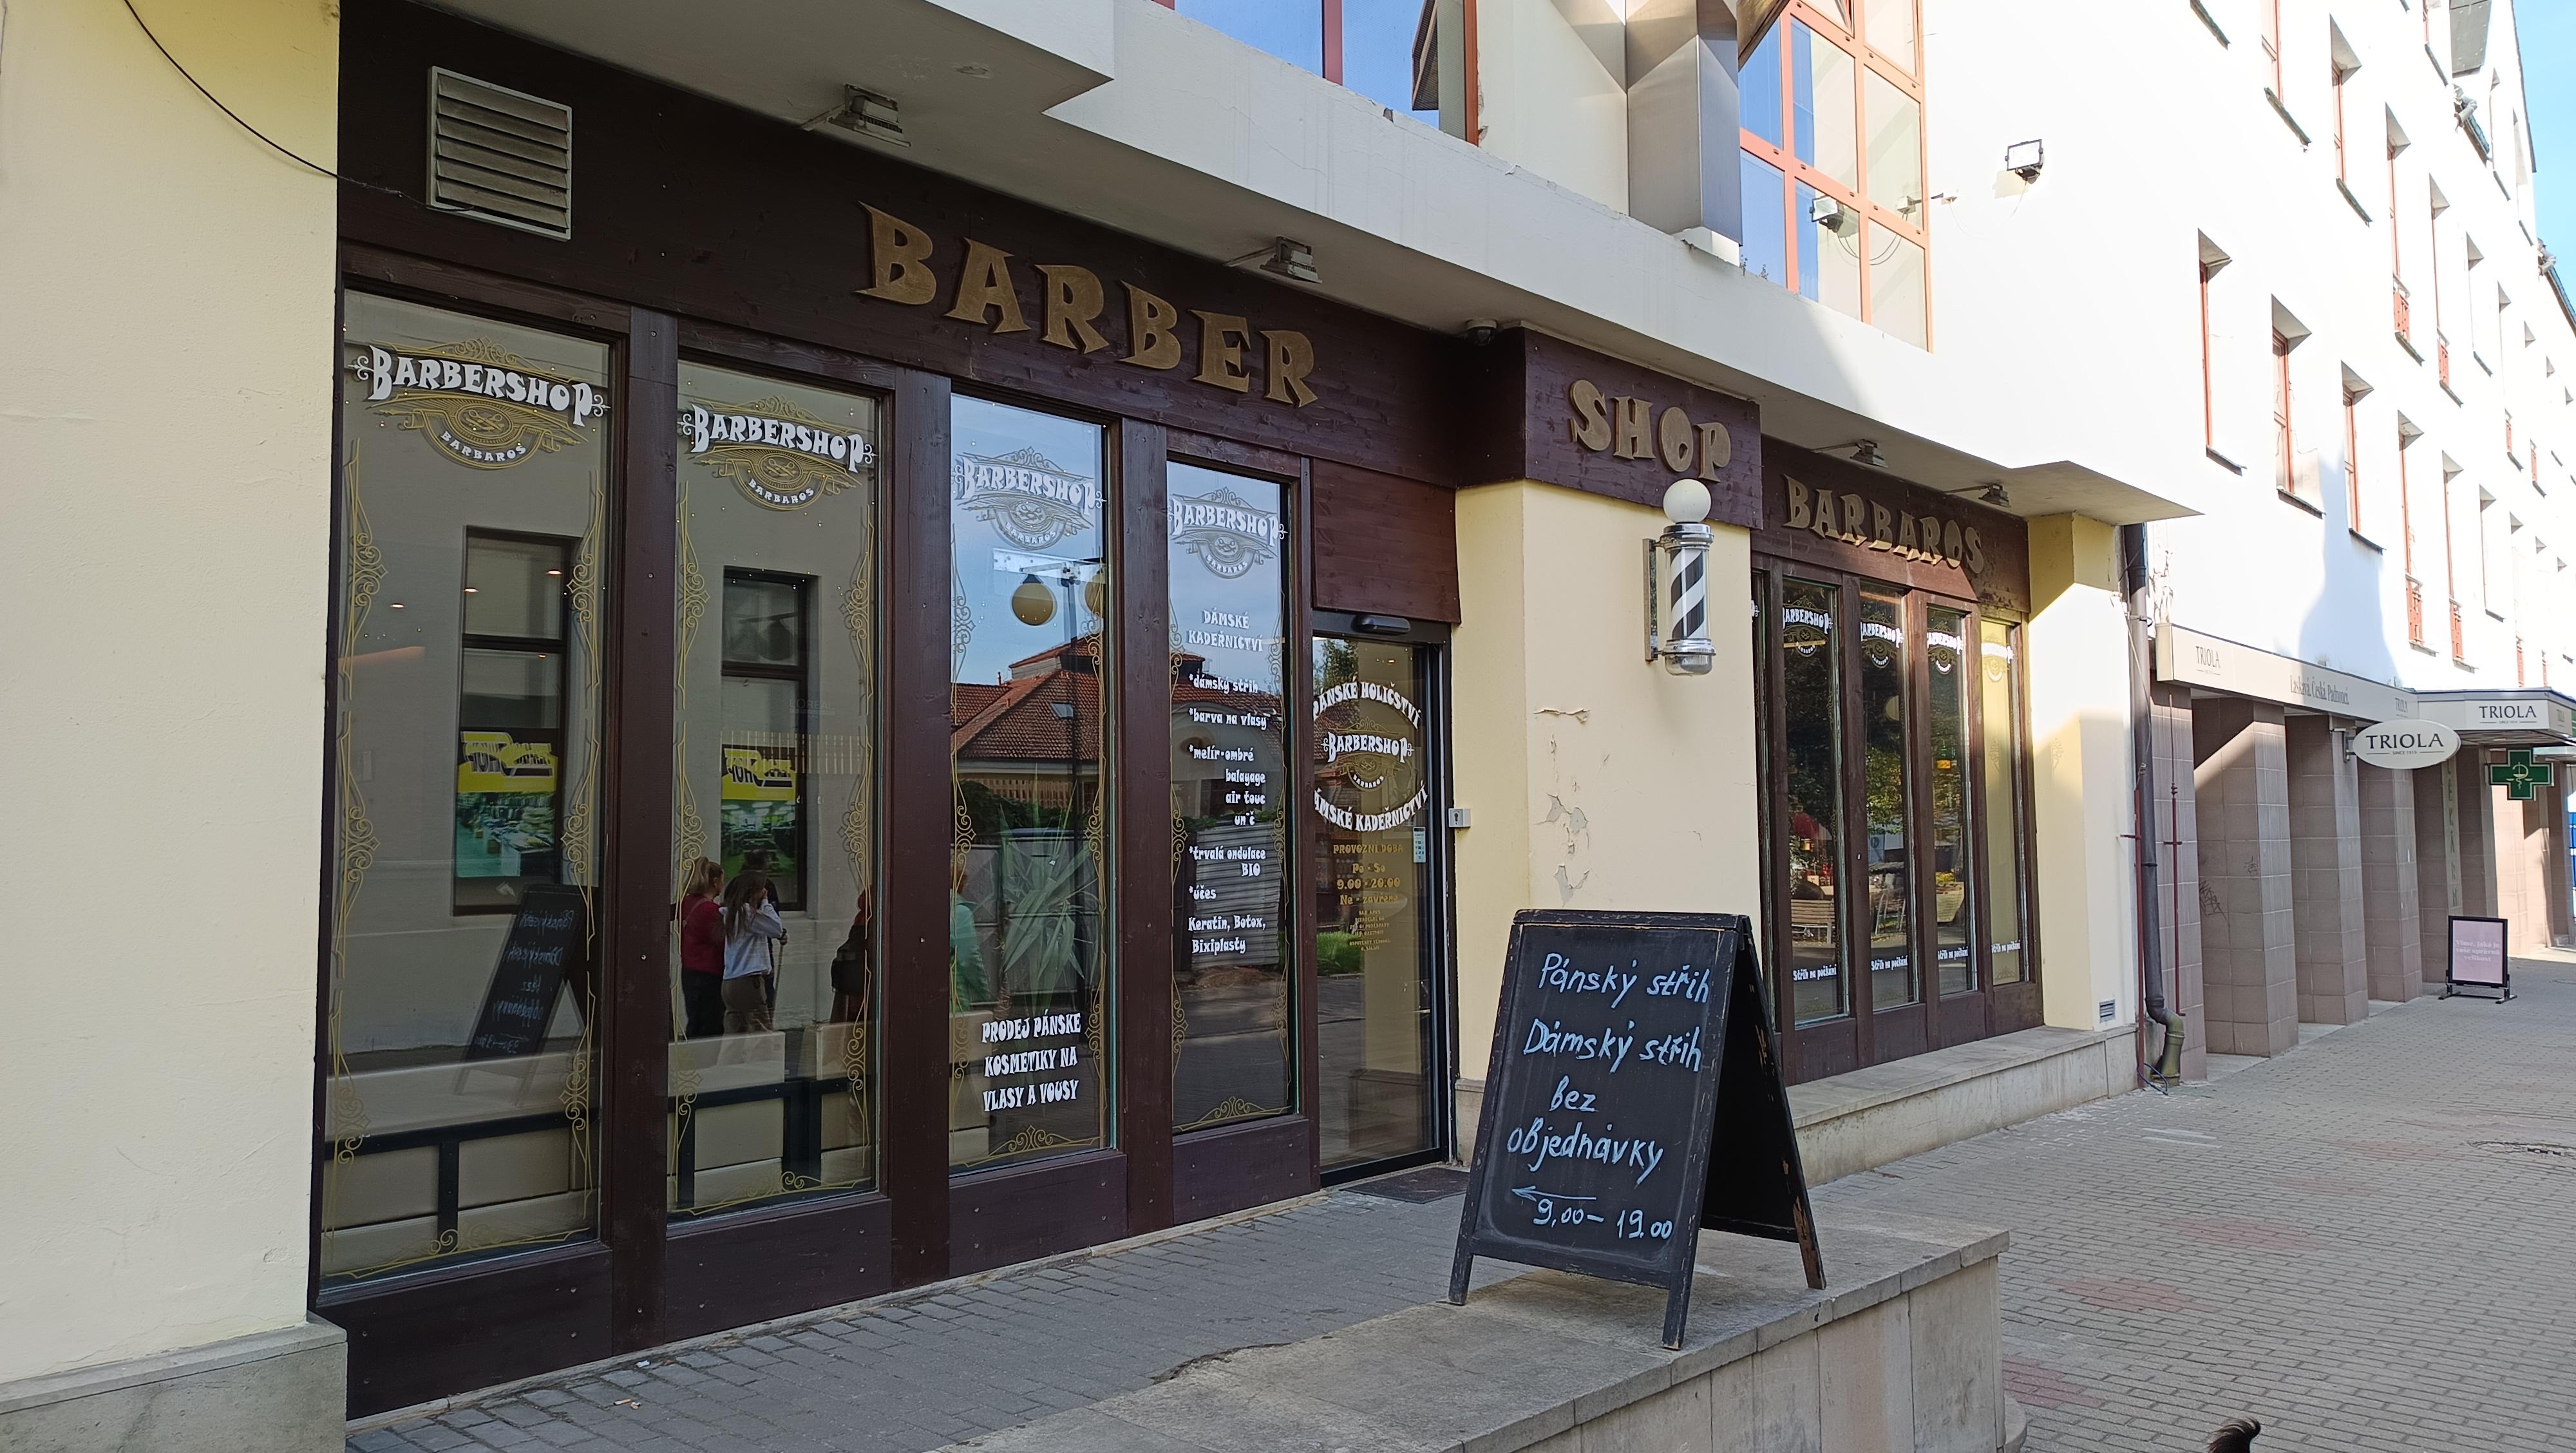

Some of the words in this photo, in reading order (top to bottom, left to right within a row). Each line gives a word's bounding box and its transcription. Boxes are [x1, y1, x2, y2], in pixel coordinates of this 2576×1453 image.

[851, 200, 1319, 408] BARBER
[368, 345, 593, 427] BARBERSHOP
[690, 403, 865, 473] BARBERSHOP
[1569, 379, 1731, 482] SHOP
[440, 430, 527, 462] BARBAROS
[748, 478, 815, 506] BARBAROS
[961, 457, 1096, 517] BARBERSHOP
[1005, 520, 1056, 546] BARBAROS
[1171, 498, 1279, 547] BARBERSHOP
[1782, 473, 1984, 574] BARBAROS
[1203, 607, 1250, 629] DÁMSKÉ
[1188, 630, 1264, 652] KADEŘNICTVÍ
[2195, 645, 2221, 669] TRIOLA
[1232, 678, 1258, 694] střih
[1313, 676, 1358, 721] PÁNSKÉ
[1360, 681, 1422, 731] HOLIČSTVÍ
[2479, 705, 2537, 718] TRIOLA
[1226, 714, 1237, 725] na
[1240, 713, 1267, 730] vlasy
[1327, 731, 1408, 763] BARBERSHOP
[2365, 734, 2444, 749] TRIOLA
[1226, 768, 1266, 786] balayage
[1226, 791, 1240, 804] air
[1244, 790, 1265, 804] touc
[1314, 788, 1352, 831] ÁMSKÉ
[1354, 779, 1428, 831] KADEŘNICTVÍ
[1226, 846, 1266, 860] ondulace
[1333, 840, 1378, 855] PROVOZNÍ
[1241, 863, 1261, 877] BIO
[1352, 863, 1364, 874] Po
[1374, 863, 1385, 873] So
[1336, 878, 1361, 890] 9.00
[1340, 895, 1354, 906] Ne
[1188, 916, 1231, 932] Keratin,
[1233, 915, 1266, 930] Botox,
[1192, 936, 1247, 956] Bixiplasty
[1538, 952, 1638, 1009] Pánský
[1646, 964, 1711, 1003] střih
[1793, 968, 1809, 981] Střih
[1810, 971, 1816, 979] na
[981, 1017, 1030, 1043] PRODEJ
[1522, 1018, 1635, 1074] Dámský
[1638, 1026, 1702, 1073] střih
[984, 1049, 1057, 1078] KOSMETIKY
[1060, 1046, 1078, 1068] NA
[983, 1087, 1025, 1112] VLASY
[1027, 1085, 1037, 1105] A
[1039, 1079, 1079, 1104] VOUSY
